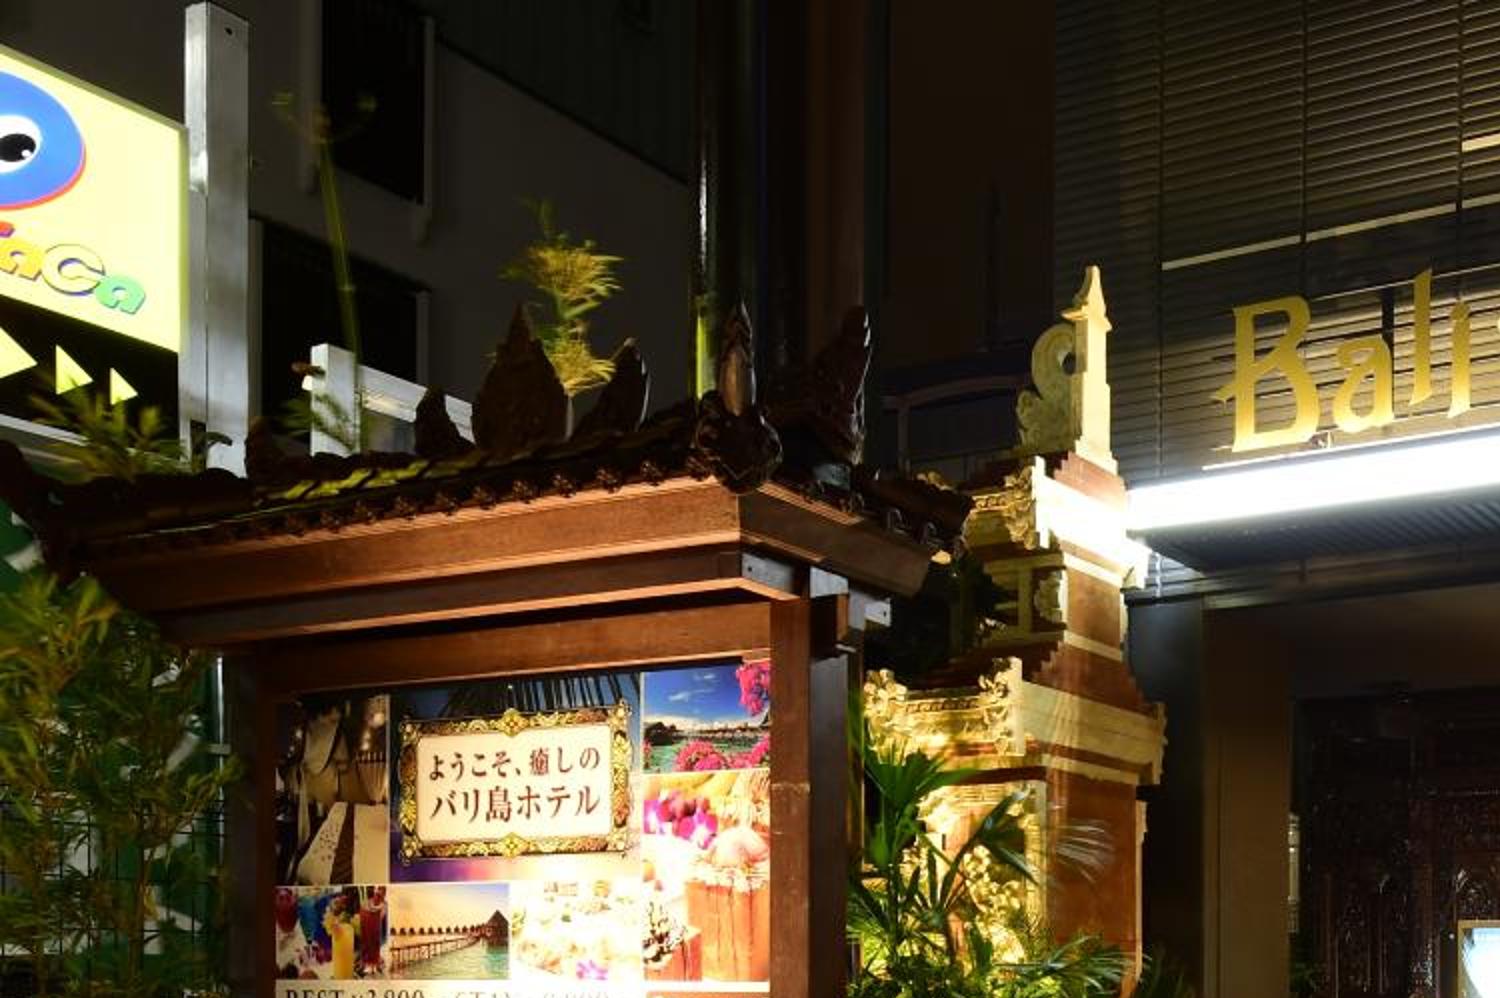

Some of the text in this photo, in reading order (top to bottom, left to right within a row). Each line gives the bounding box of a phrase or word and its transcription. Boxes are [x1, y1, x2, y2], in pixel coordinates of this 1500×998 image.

[1213, 266, 1472, 454] Bali
[429, 746, 600, 782] ようこそ、癒しの
[430, 785, 600, 823] バリ島ホテル
